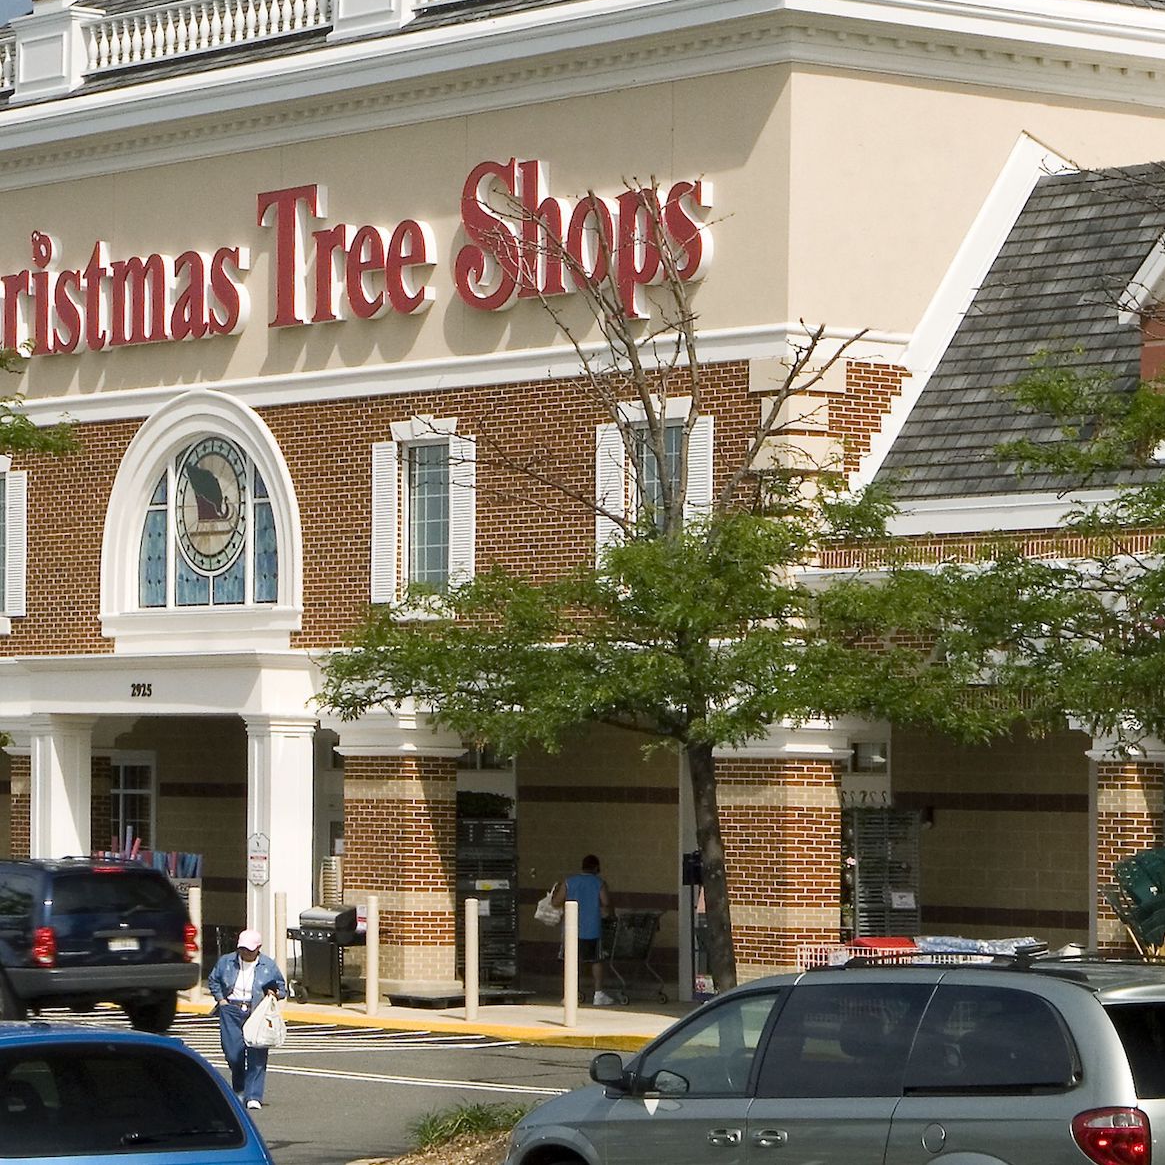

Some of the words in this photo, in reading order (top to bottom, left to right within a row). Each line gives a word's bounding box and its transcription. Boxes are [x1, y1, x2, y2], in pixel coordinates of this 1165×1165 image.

[0, 230, 244, 356] ristmas
[257, 184, 431, 328] Tree
[454, 157, 708, 320] Shops
[131, 682, 152, 698] 2925
